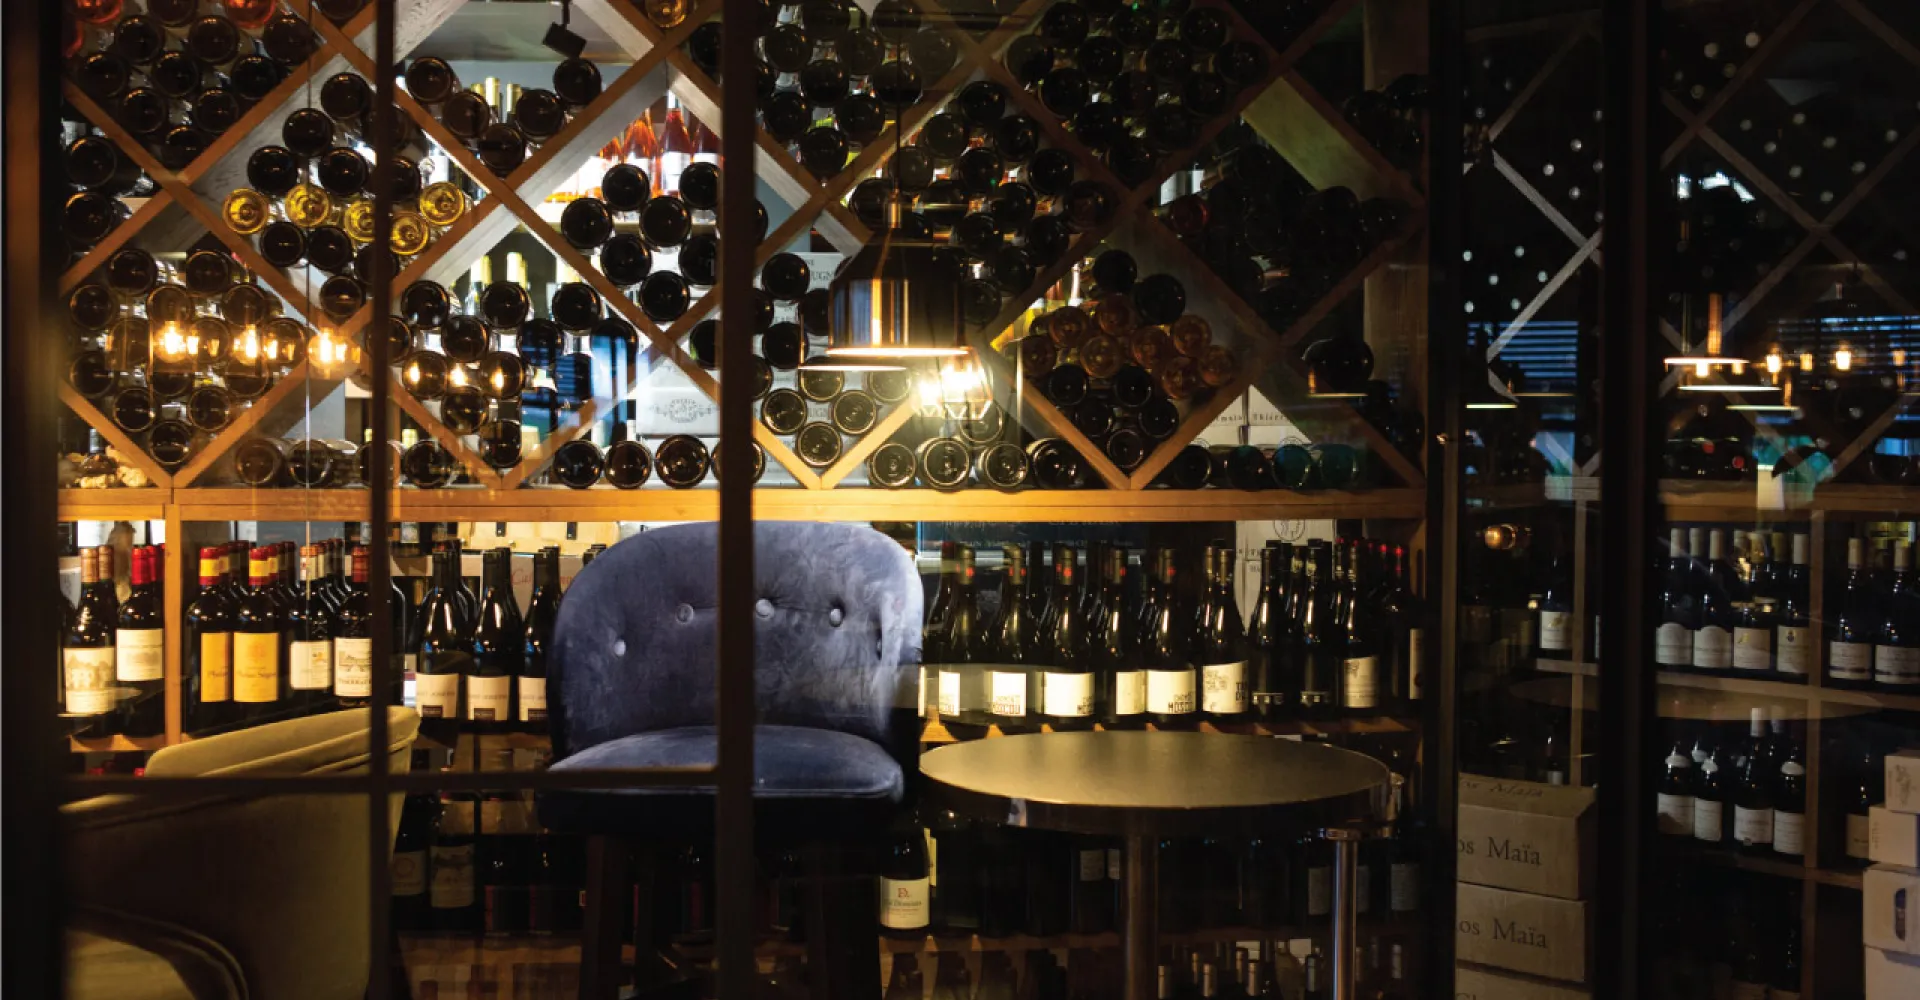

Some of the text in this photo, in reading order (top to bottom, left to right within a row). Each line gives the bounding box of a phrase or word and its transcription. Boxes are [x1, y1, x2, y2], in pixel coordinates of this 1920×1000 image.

[1487, 836, 1542, 866] Maïa
[1457, 917, 1548, 949] os Maïa
